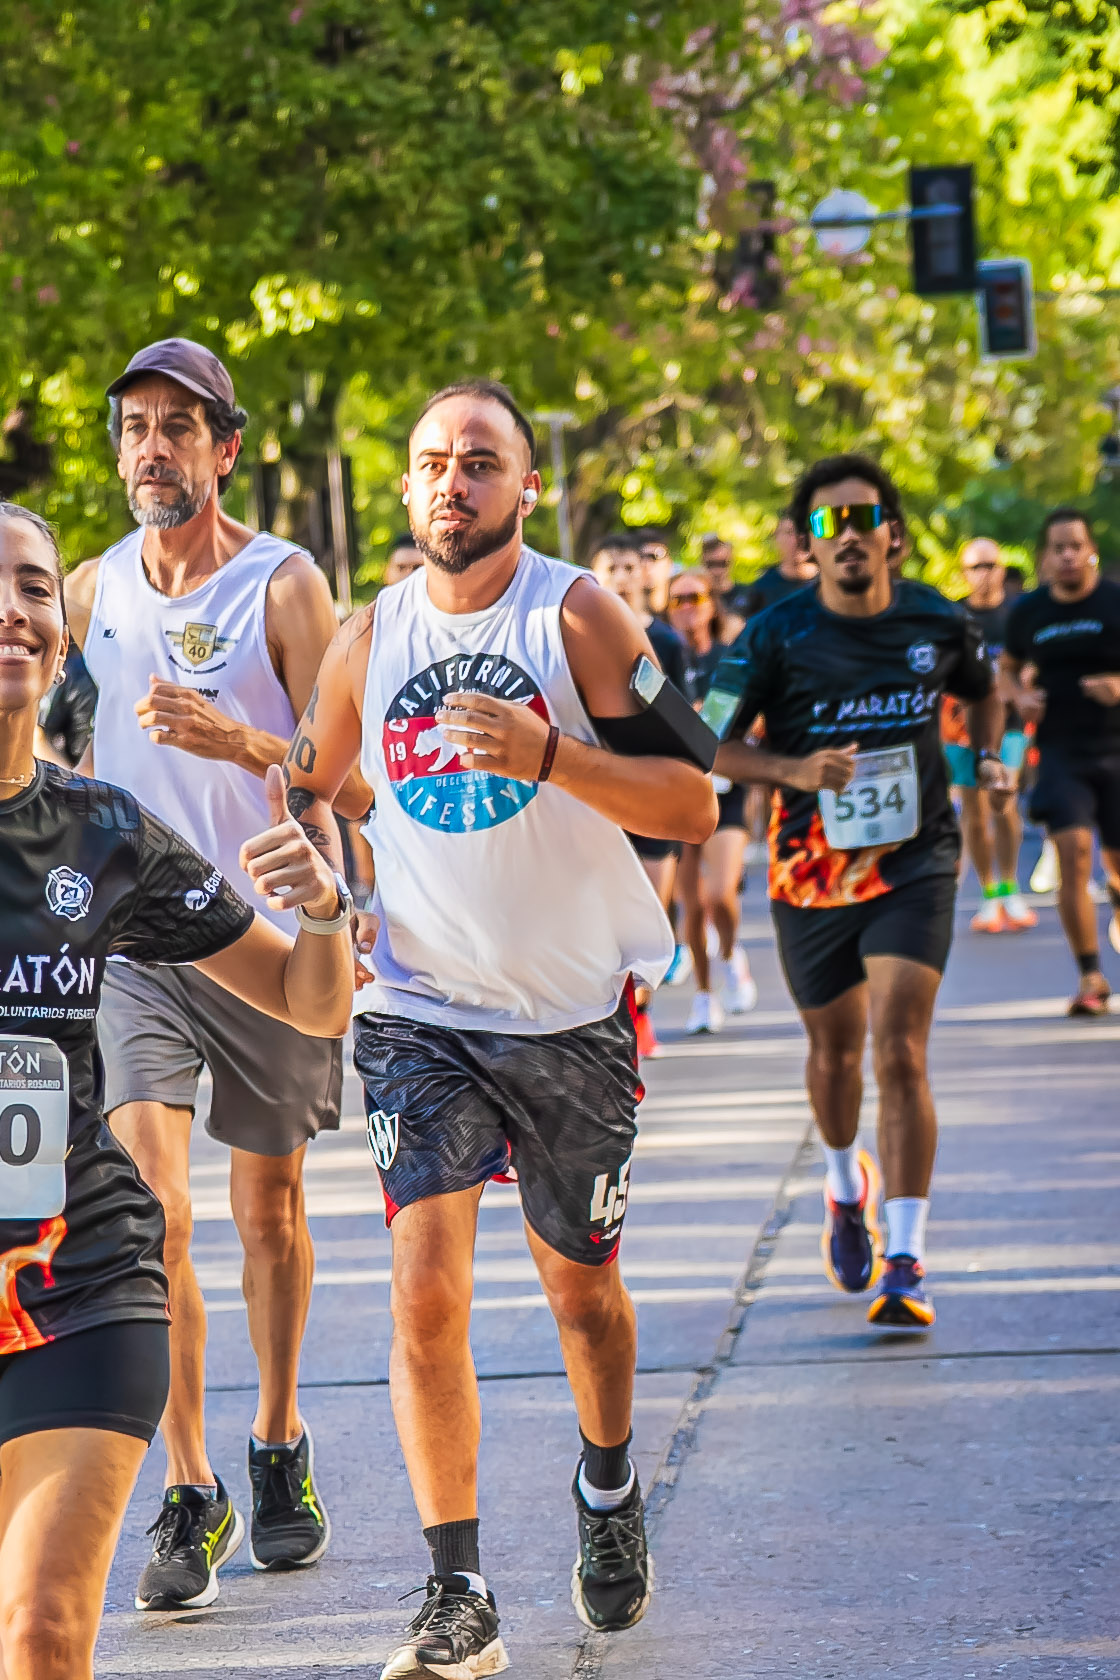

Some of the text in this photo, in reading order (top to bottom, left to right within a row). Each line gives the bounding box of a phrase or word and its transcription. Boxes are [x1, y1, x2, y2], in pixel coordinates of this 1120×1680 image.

[188, 645, 207, 659] 40
[389, 741, 407, 763] 19
[835, 781, 905, 823] 534
[60, 883, 79, 901] 27
[27, 1080, 61, 1089] ROSARIO
